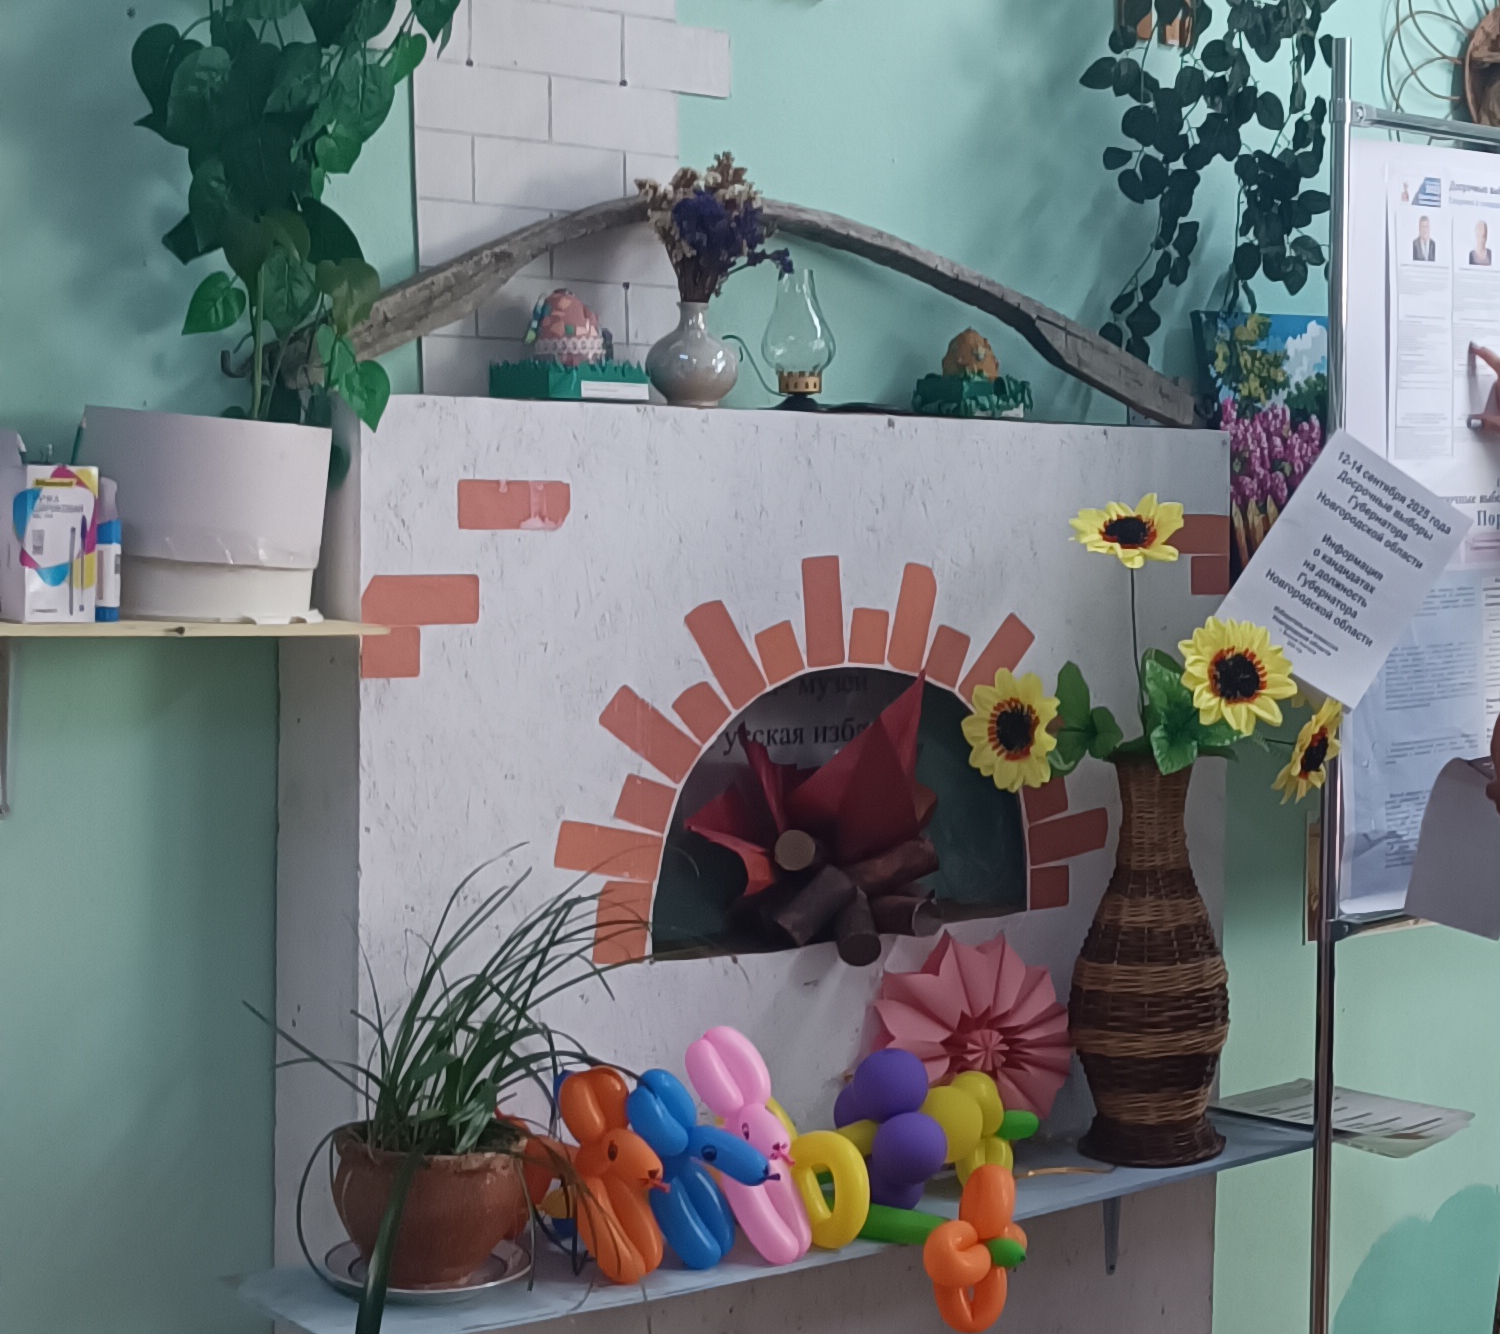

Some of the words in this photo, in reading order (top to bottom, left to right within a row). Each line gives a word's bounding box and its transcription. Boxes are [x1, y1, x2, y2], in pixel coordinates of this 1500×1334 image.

[1337, 469, 1393, 513] Досрочные
[1392, 509, 1434, 541] выборы
[1338, 451, 1363, 474] 12-14
[1362, 470, 1407, 504] сентября
[1406, 498, 1431, 520] 2025
[1428, 515, 1452, 534] года
[1316, 489, 1384, 543] Новгородской
[1383, 539, 1424, 570] области
[1347, 494, 1409, 542] Губернатора
[1312, 547, 1321, 557] о
[1321, 553, 1376, 595] кандидатах
[1321, 533, 1384, 582] Информация
[1265, 568, 1333, 621] Новгородской
[1333, 617, 1374, 648] области
[1296, 571, 1358, 619] Губернатора
[1302, 559, 1316, 573] на
[1314, 568, 1368, 608] должность
